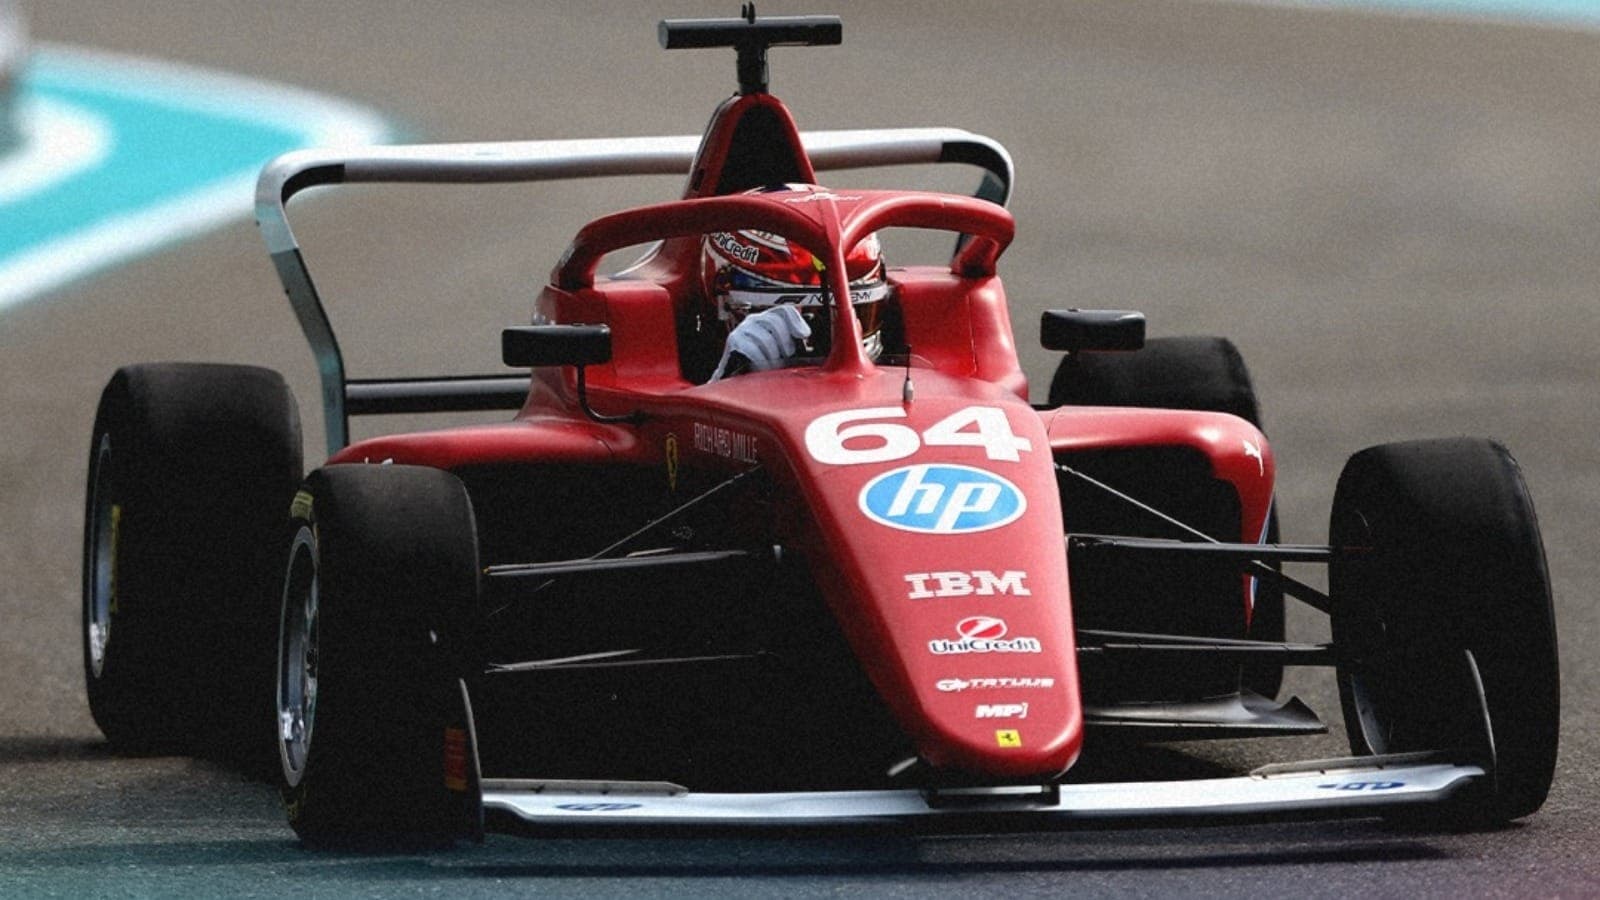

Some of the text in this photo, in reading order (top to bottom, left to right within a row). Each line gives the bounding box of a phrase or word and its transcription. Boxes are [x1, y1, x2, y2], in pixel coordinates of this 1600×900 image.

[713, 232, 759, 264] niCredit
[804, 406, 1033, 466] 64
[887, 466, 1002, 531] hp
[904, 570, 1032, 600] IBM
[930, 638, 1040, 654] UniCredit
